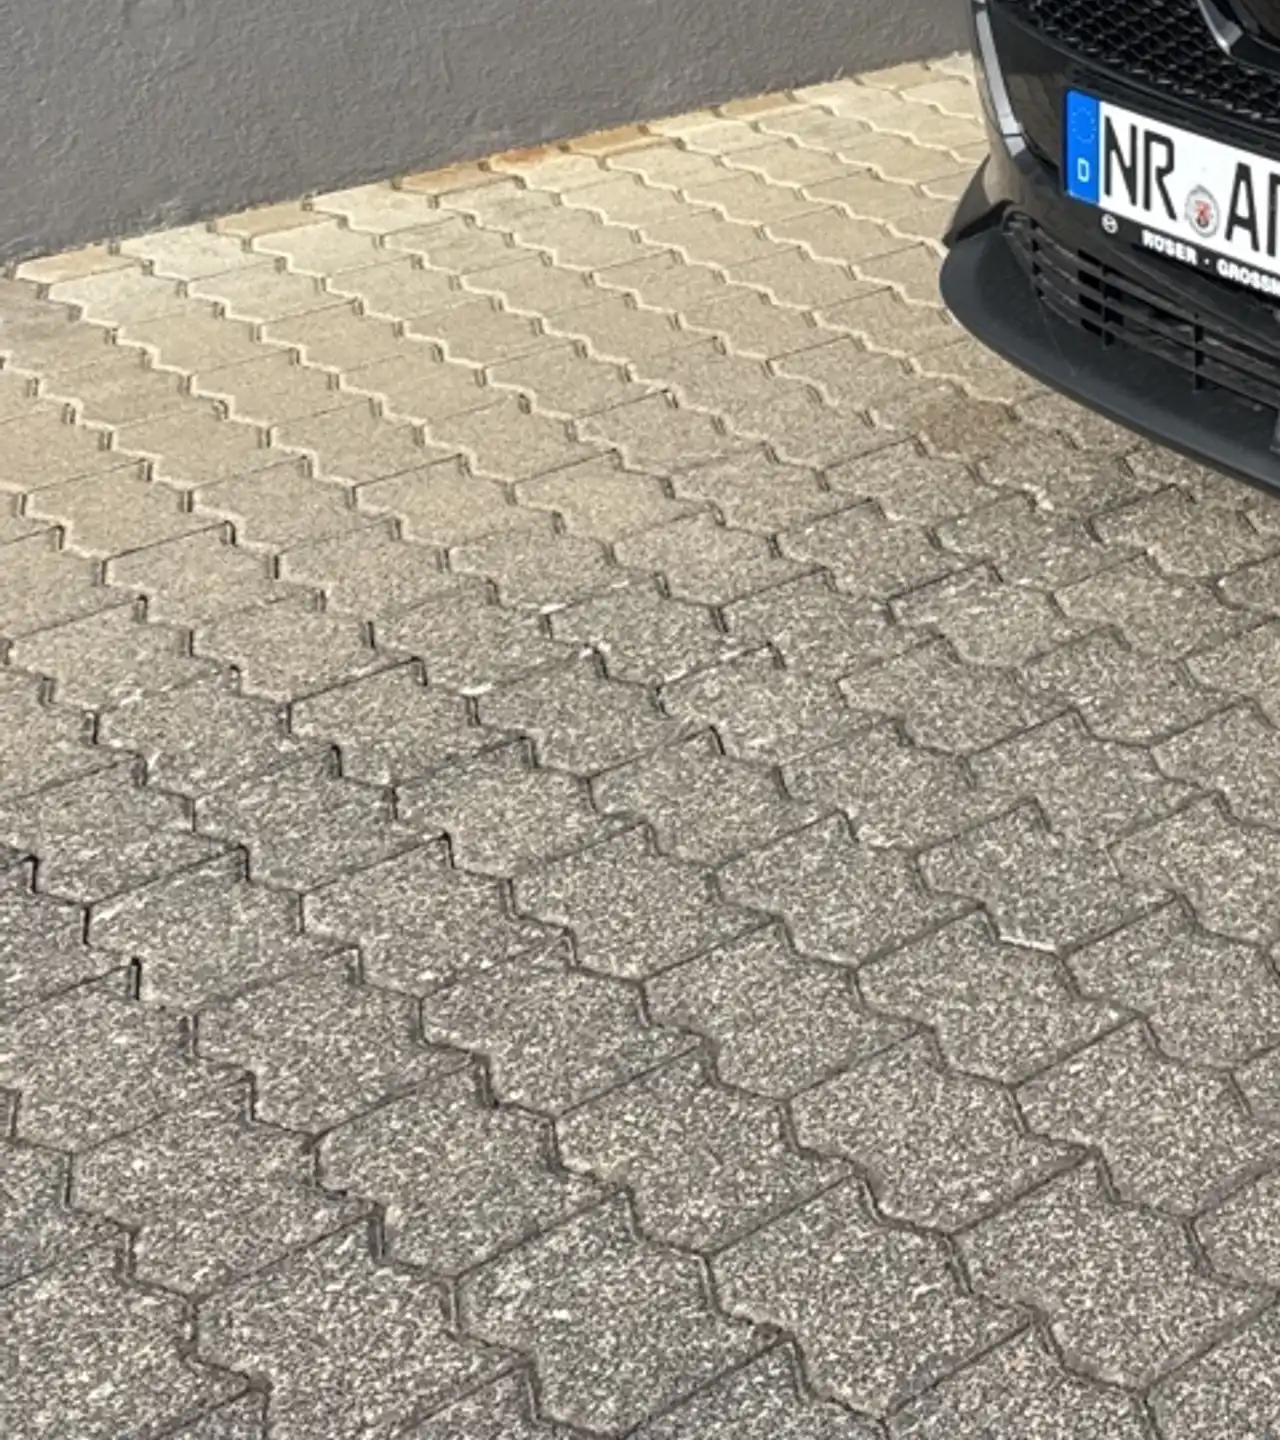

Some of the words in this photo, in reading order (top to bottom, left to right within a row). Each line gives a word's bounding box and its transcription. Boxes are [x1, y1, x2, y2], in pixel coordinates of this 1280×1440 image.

[1077, 158, 1090, 182] D
[1104, 115, 1177, 221] NR
[1141, 230, 1199, 266] ROSER
